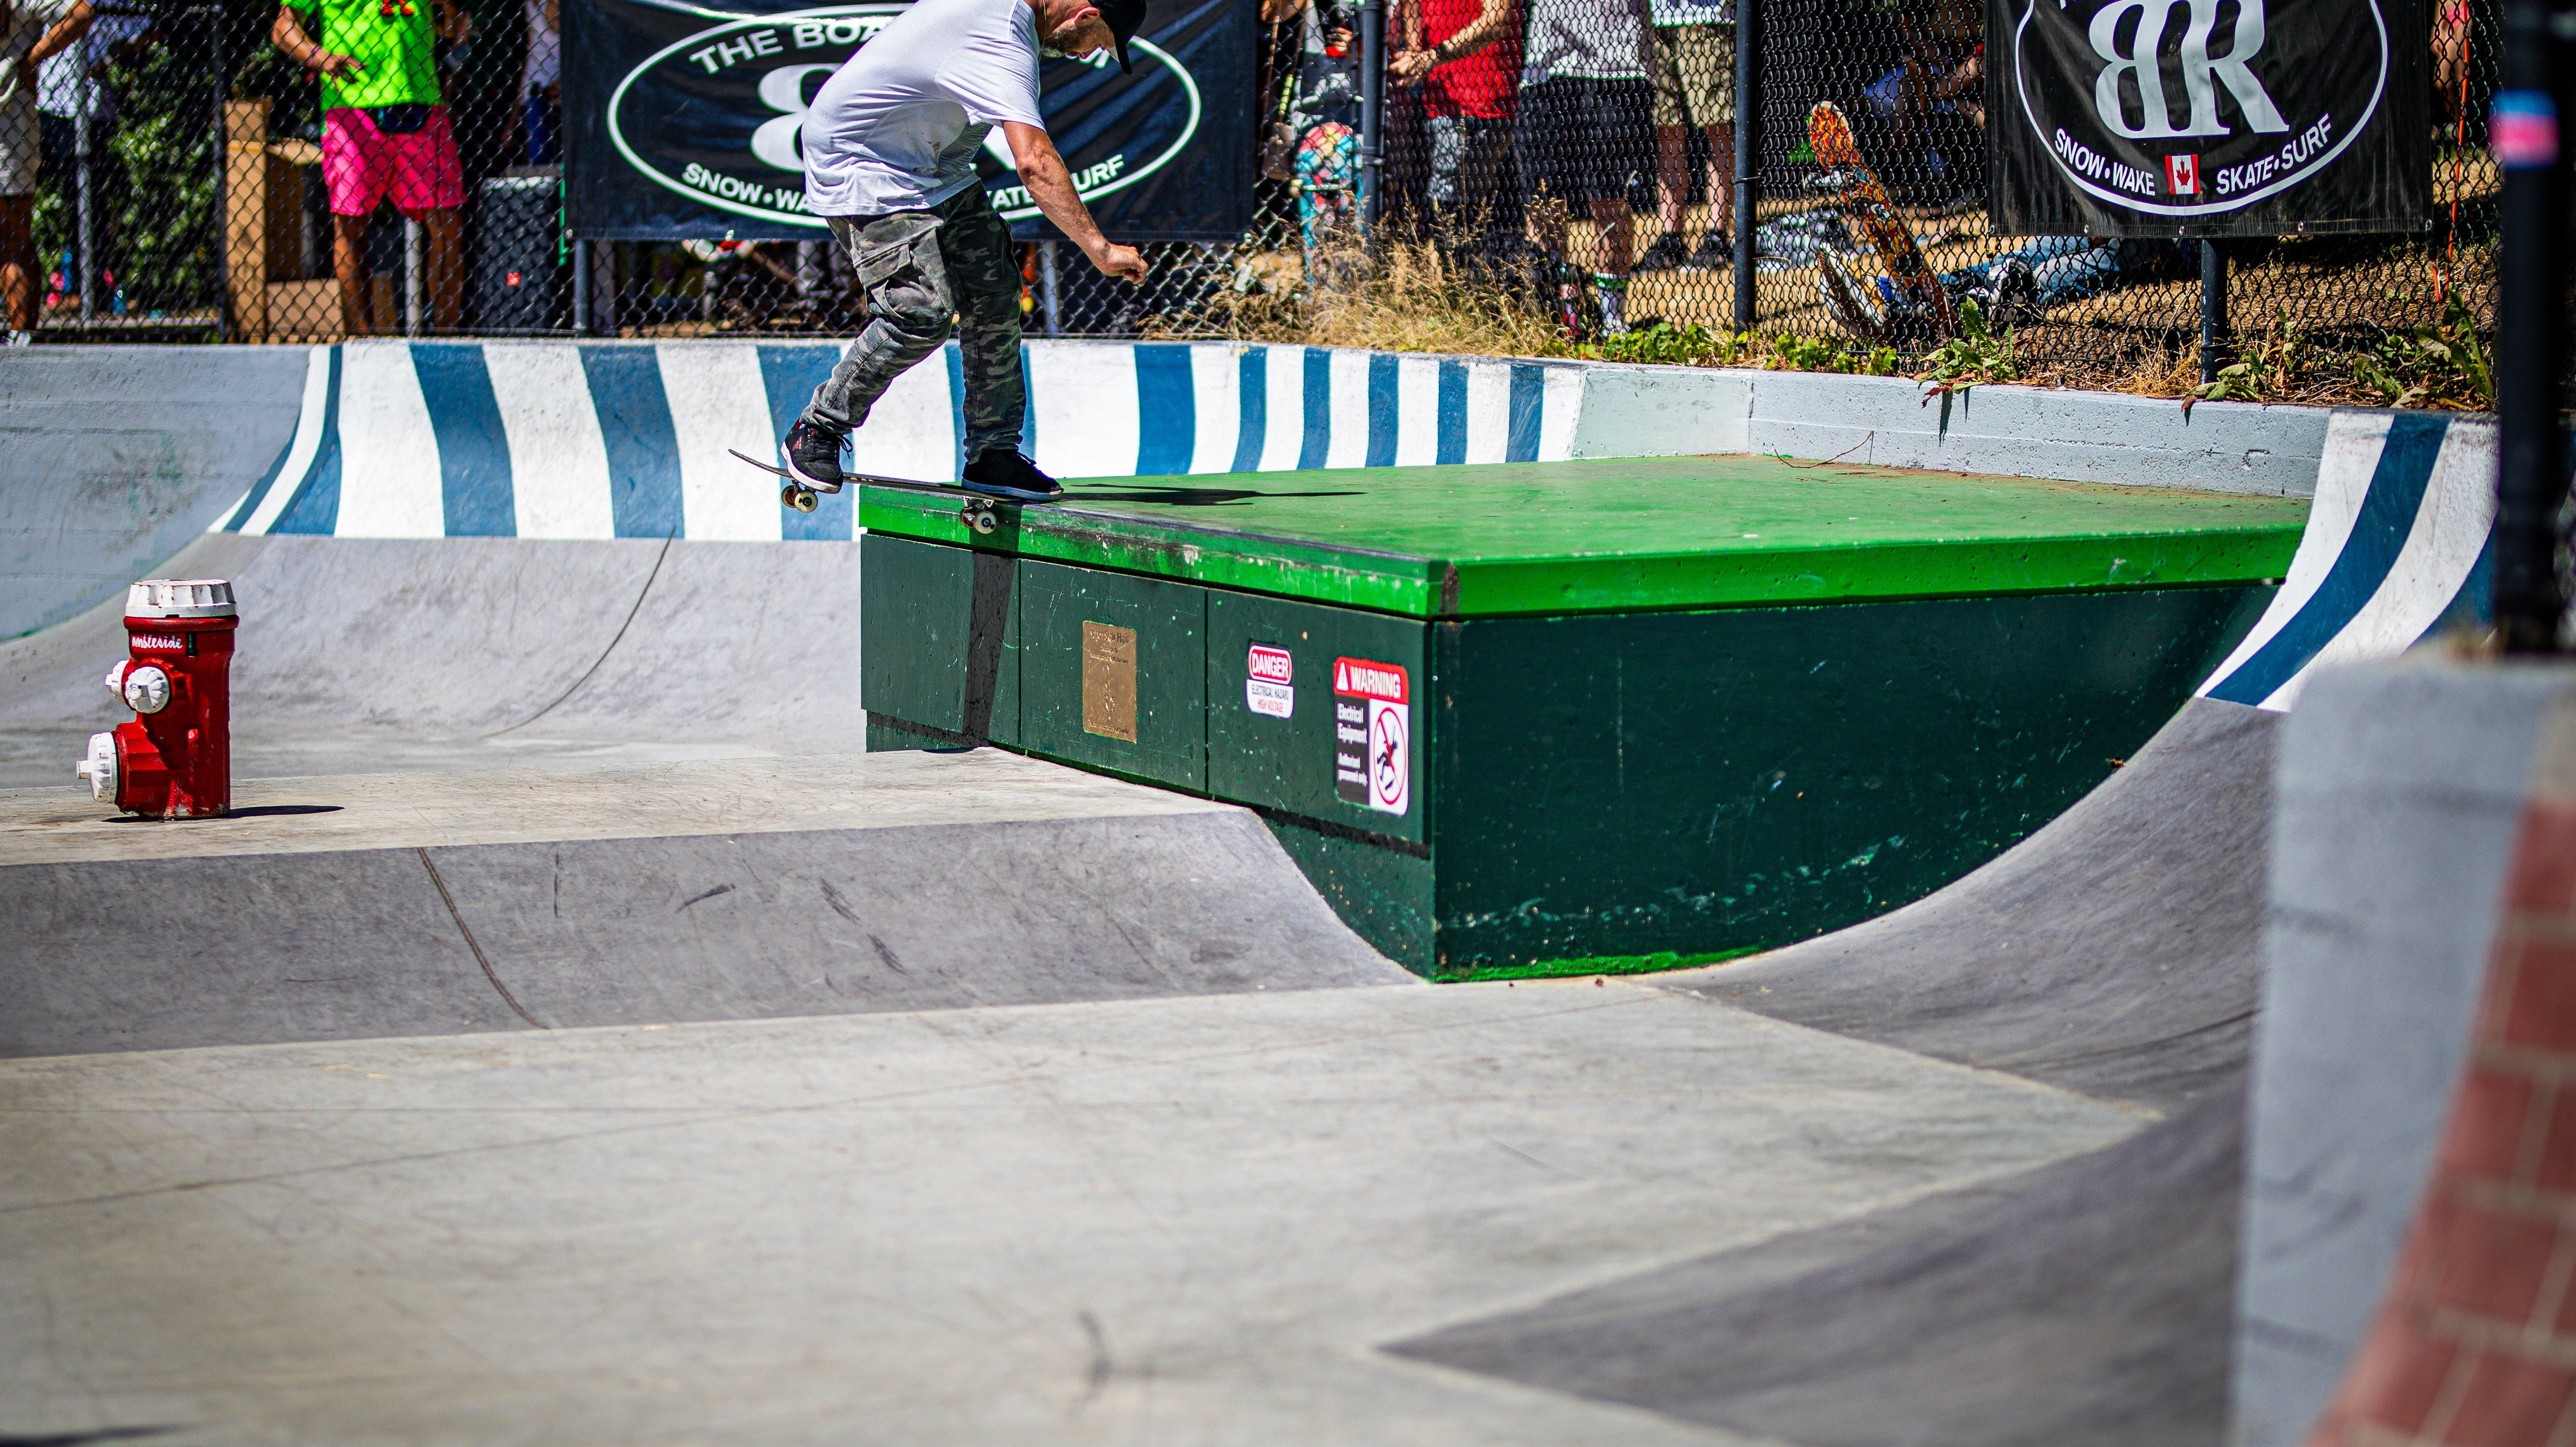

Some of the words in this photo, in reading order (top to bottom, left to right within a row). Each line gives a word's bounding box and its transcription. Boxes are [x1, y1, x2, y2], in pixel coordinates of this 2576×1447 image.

[690, 29, 784, 74] THE
[2055, 128, 2106, 179] SNOW
[2113, 162, 2155, 196] WAKE
[2216, 155, 2274, 194] SKATE
[2282, 112, 2331, 170] SURF
[683, 162, 763, 204] SNOW
[1072, 154, 1124, 192] URF
[1251, 652, 1289, 678] DANGER
[1252, 684, 1274, 697] ELECTRICAL
[1350, 666, 1401, 699] WARNING
[1337, 703, 1364, 724] Electrical
[1337, 723, 1367, 745] Equipment
